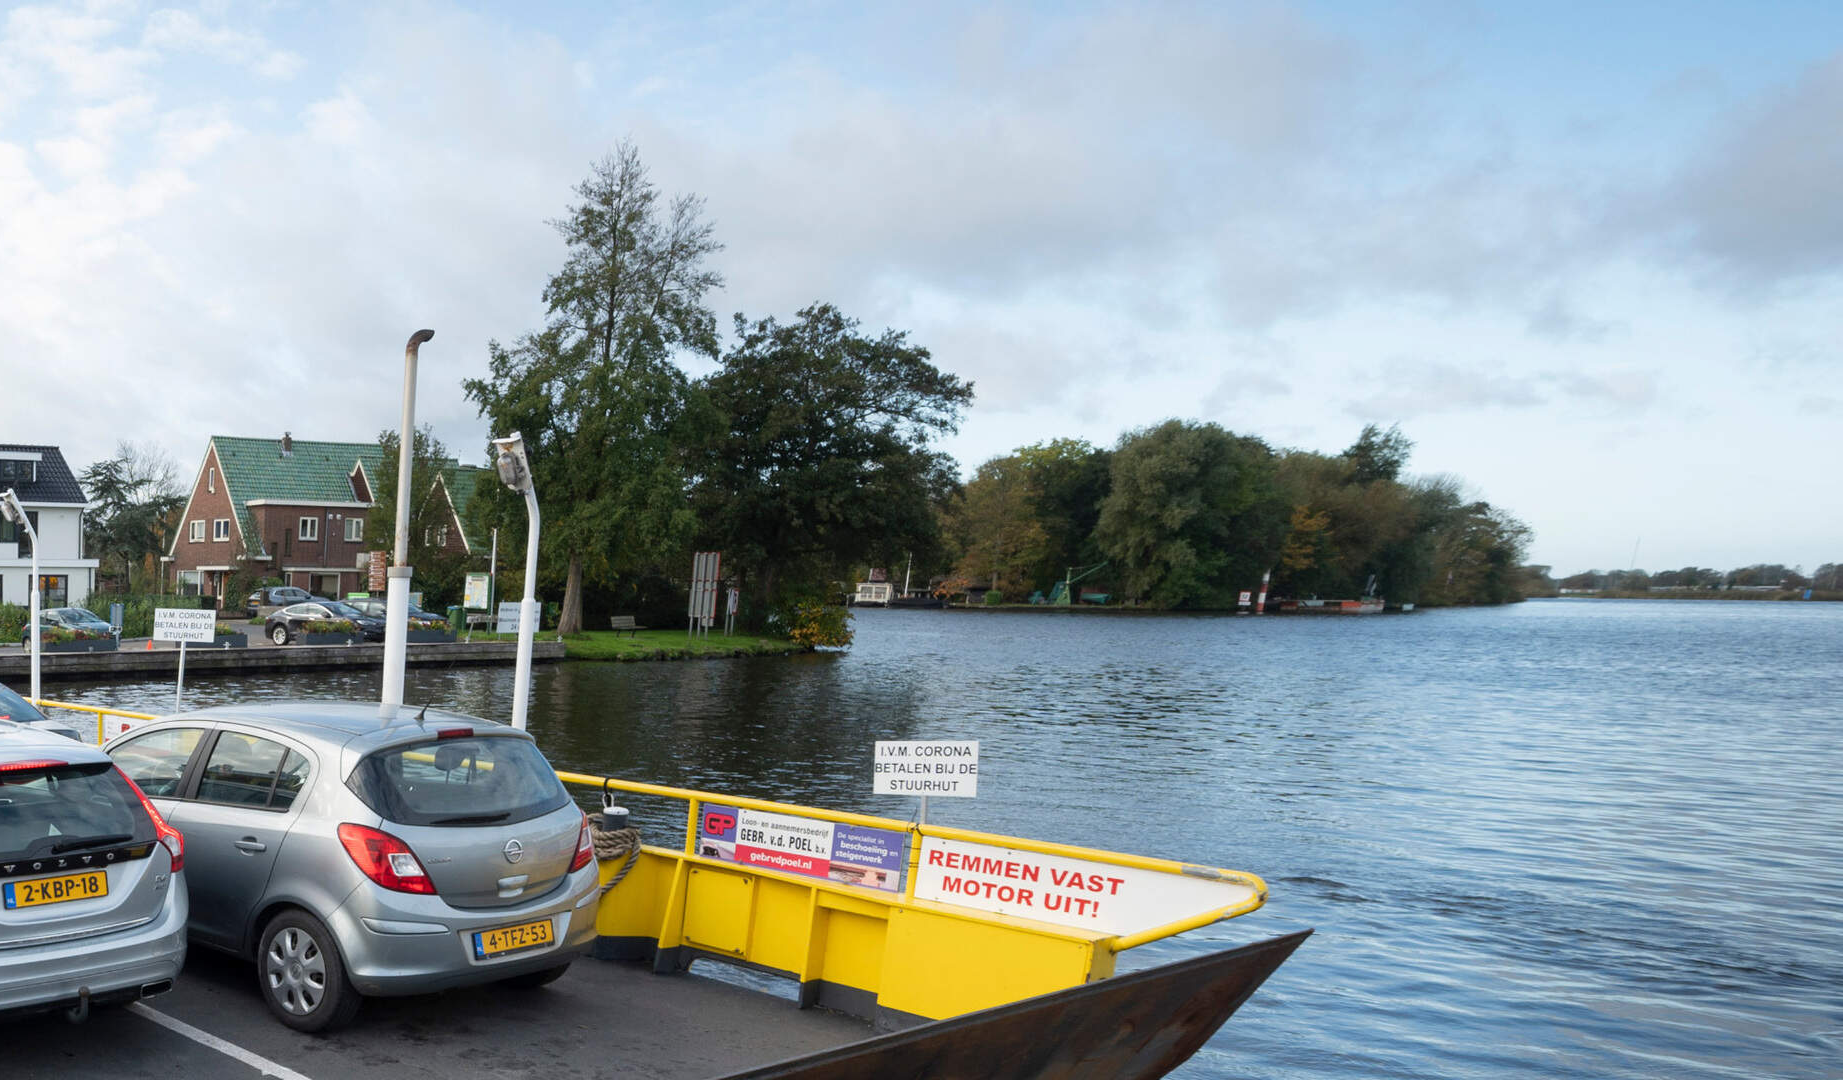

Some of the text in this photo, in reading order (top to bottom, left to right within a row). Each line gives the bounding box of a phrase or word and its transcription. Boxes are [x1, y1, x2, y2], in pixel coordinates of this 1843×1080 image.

[155, 621, 214, 630] BETALEN BIJ DE
[178, 612, 212, 620] CORONA
[163, 631, 204, 640] STUURHUT
[880, 746, 972, 757] I.V.M. CORONA
[875, 763, 977, 775] BETALEN BIJ DE
[890, 779, 959, 792] STUURHUT
[705, 812, 737, 836] GP
[741, 817, 760, 827] Loon-
[770, 821, 829, 839] aannemersbedrijf
[740, 828, 767, 844] GEBR.
[770, 835, 786, 847] v.d.
[788, 836, 812, 852] POEL
[837, 831, 885, 845] De specialist in
[3, 852, 115, 873] VOLVO
[750, 850, 812, 870] gebrvdpoel.nl
[835, 849, 883, 865] steigerwerk
[928, 849, 1125, 896] REMMEN VAST
[23, 876, 99, 903] 2-KBP-18
[942, 875, 1100, 918] MOTOR UIT!
[489, 924, 547, 949] 4-TFZ-53
